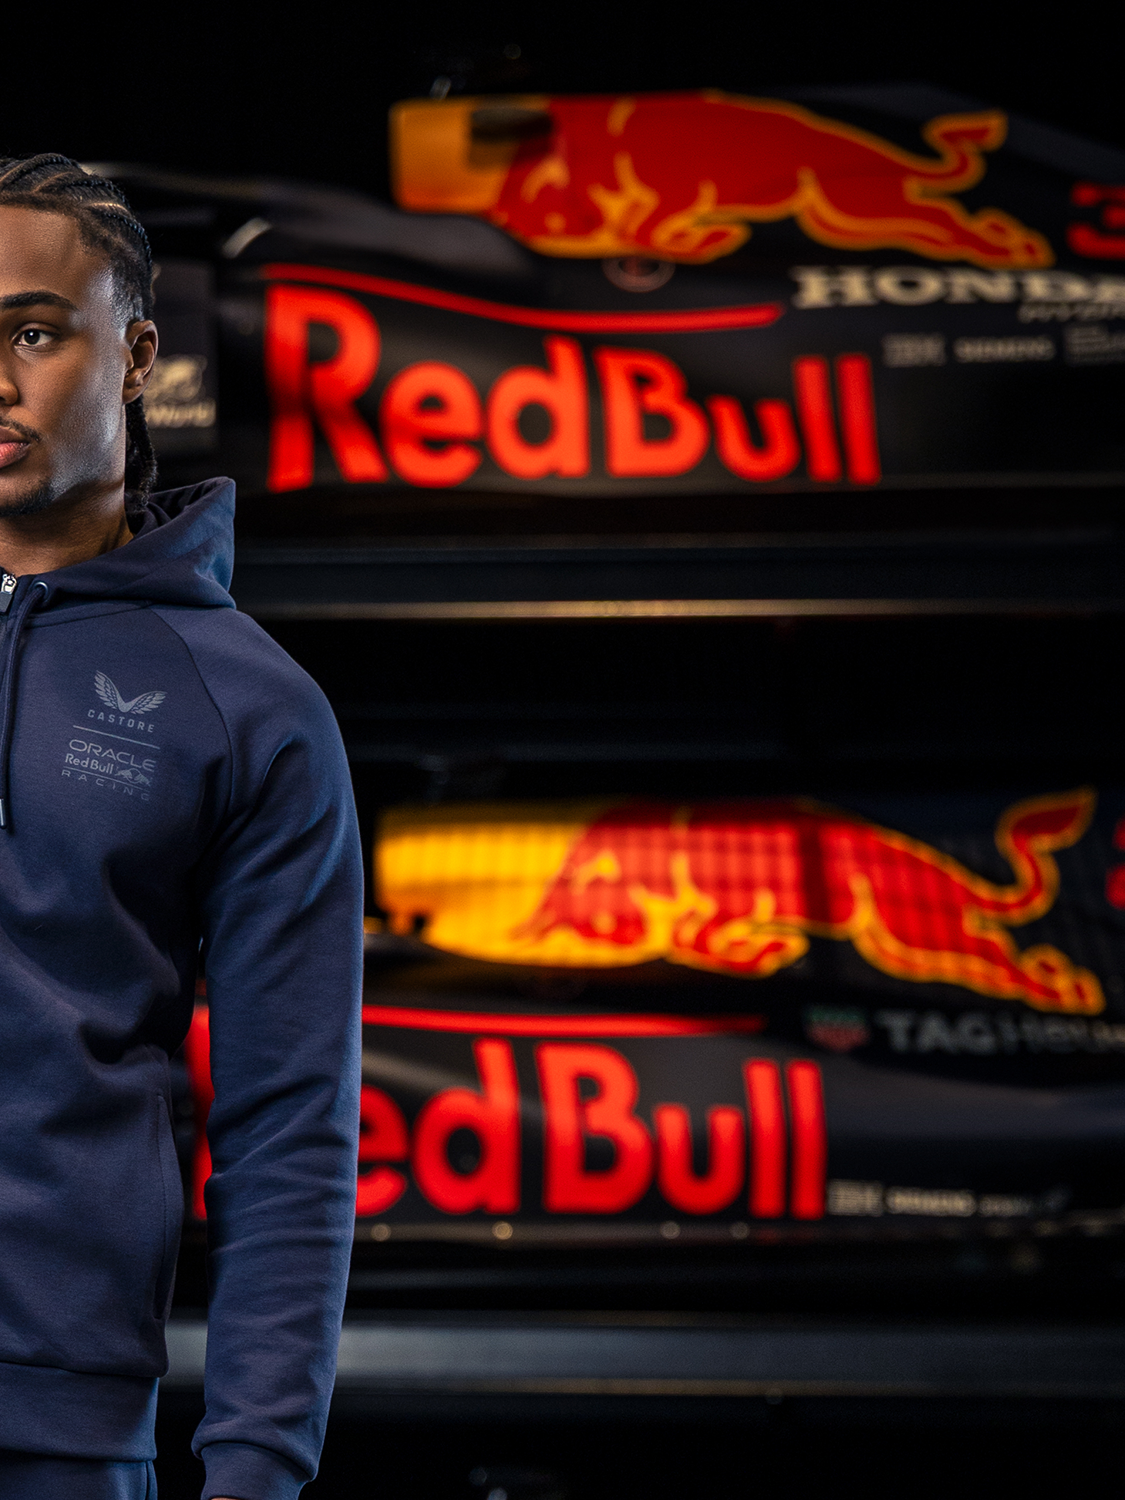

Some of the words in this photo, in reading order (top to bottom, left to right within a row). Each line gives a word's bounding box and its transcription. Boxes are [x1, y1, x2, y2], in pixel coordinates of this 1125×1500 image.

[264, 282, 591, 493] Red
[593, 343, 881, 486] Bull
[87, 709, 155, 733] CASTORE
[65, 753, 90, 768] Red
[90, 759, 114, 774] Bull
[69, 739, 157, 773] ORACLE
[61, 769, 150, 801] RACING
[876, 1008, 998, 1055] TAG
[534, 1040, 828, 1222] Bull
